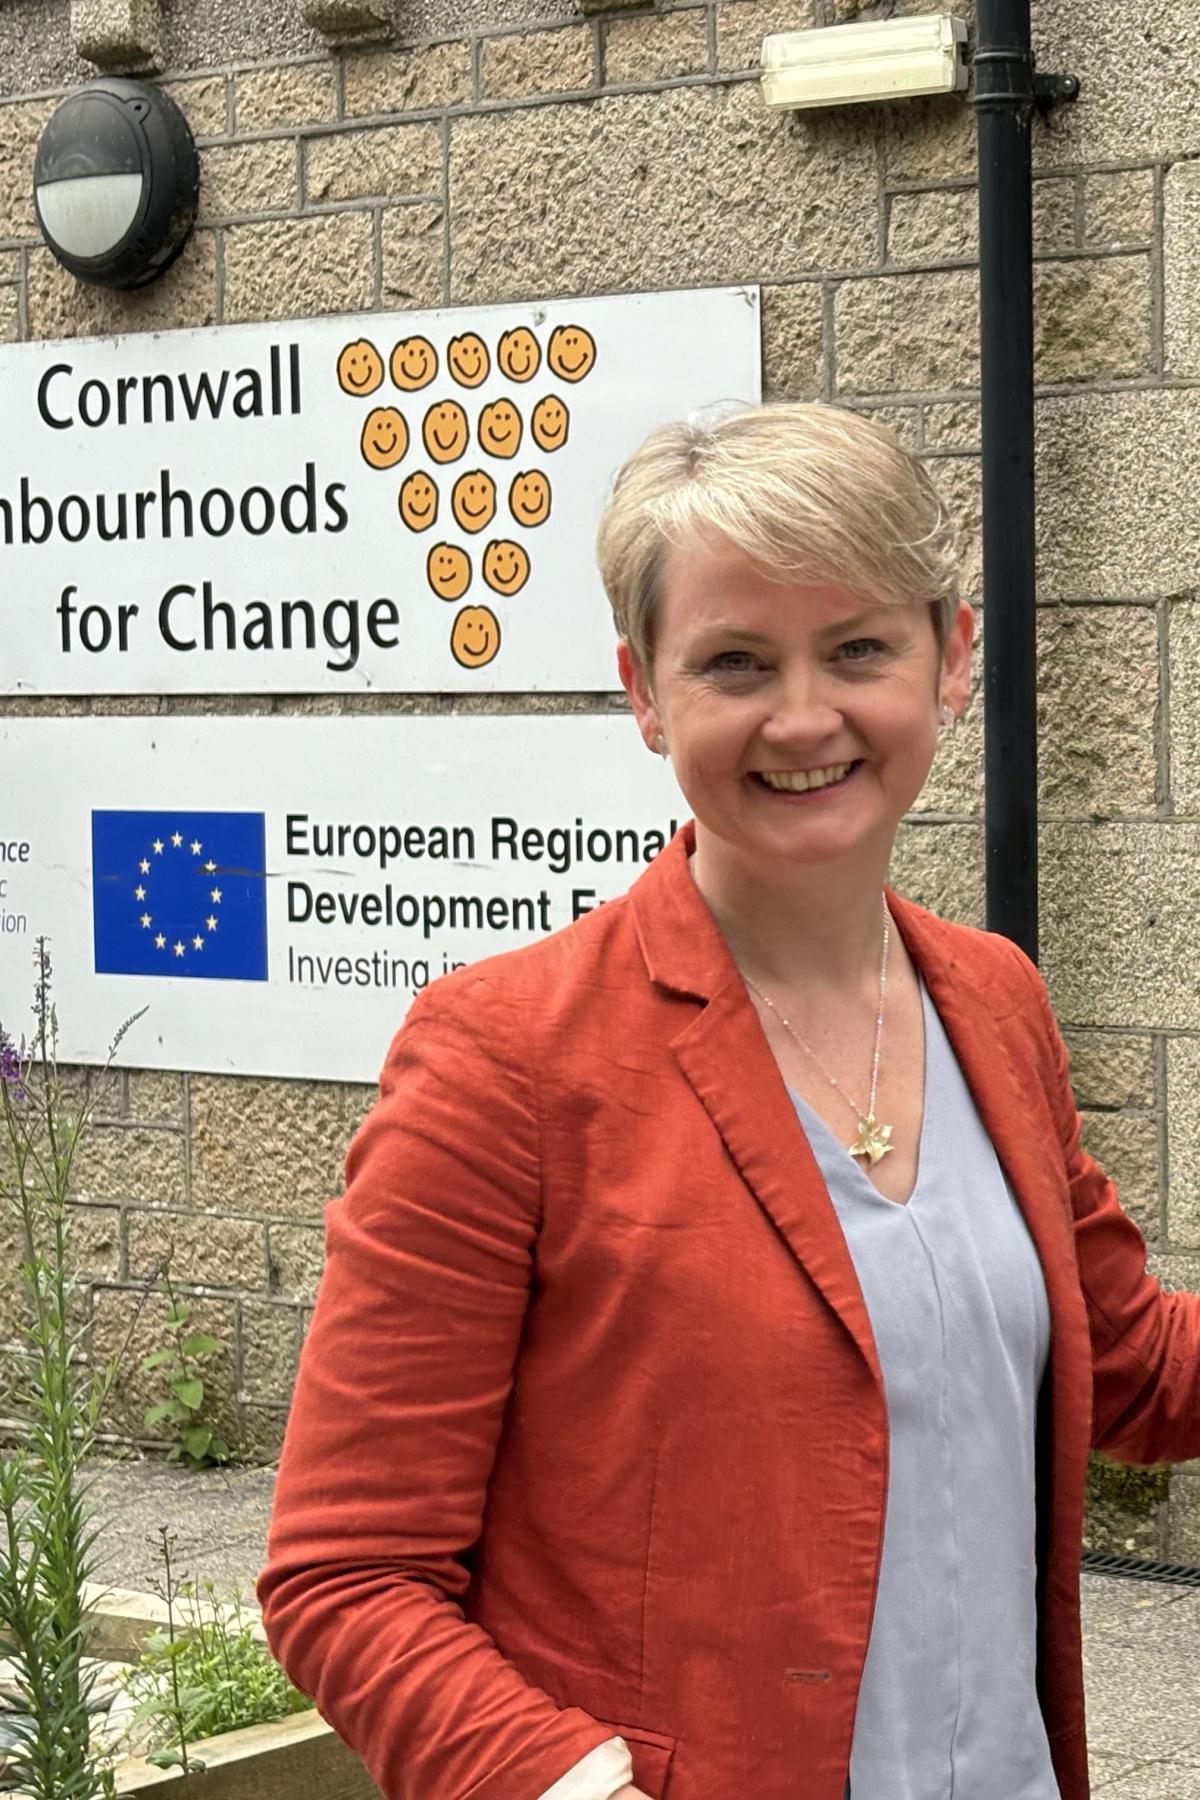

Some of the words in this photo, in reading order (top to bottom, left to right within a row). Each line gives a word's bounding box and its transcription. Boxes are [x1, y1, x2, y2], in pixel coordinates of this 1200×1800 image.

[37, 344, 302, 430] Cornwall
[56, 585, 139, 653] for
[158, 581, 400, 672] Change
[286, 814, 475, 869] European
[287, 881, 552, 939] Development
[288, 945, 430, 997] Investing
